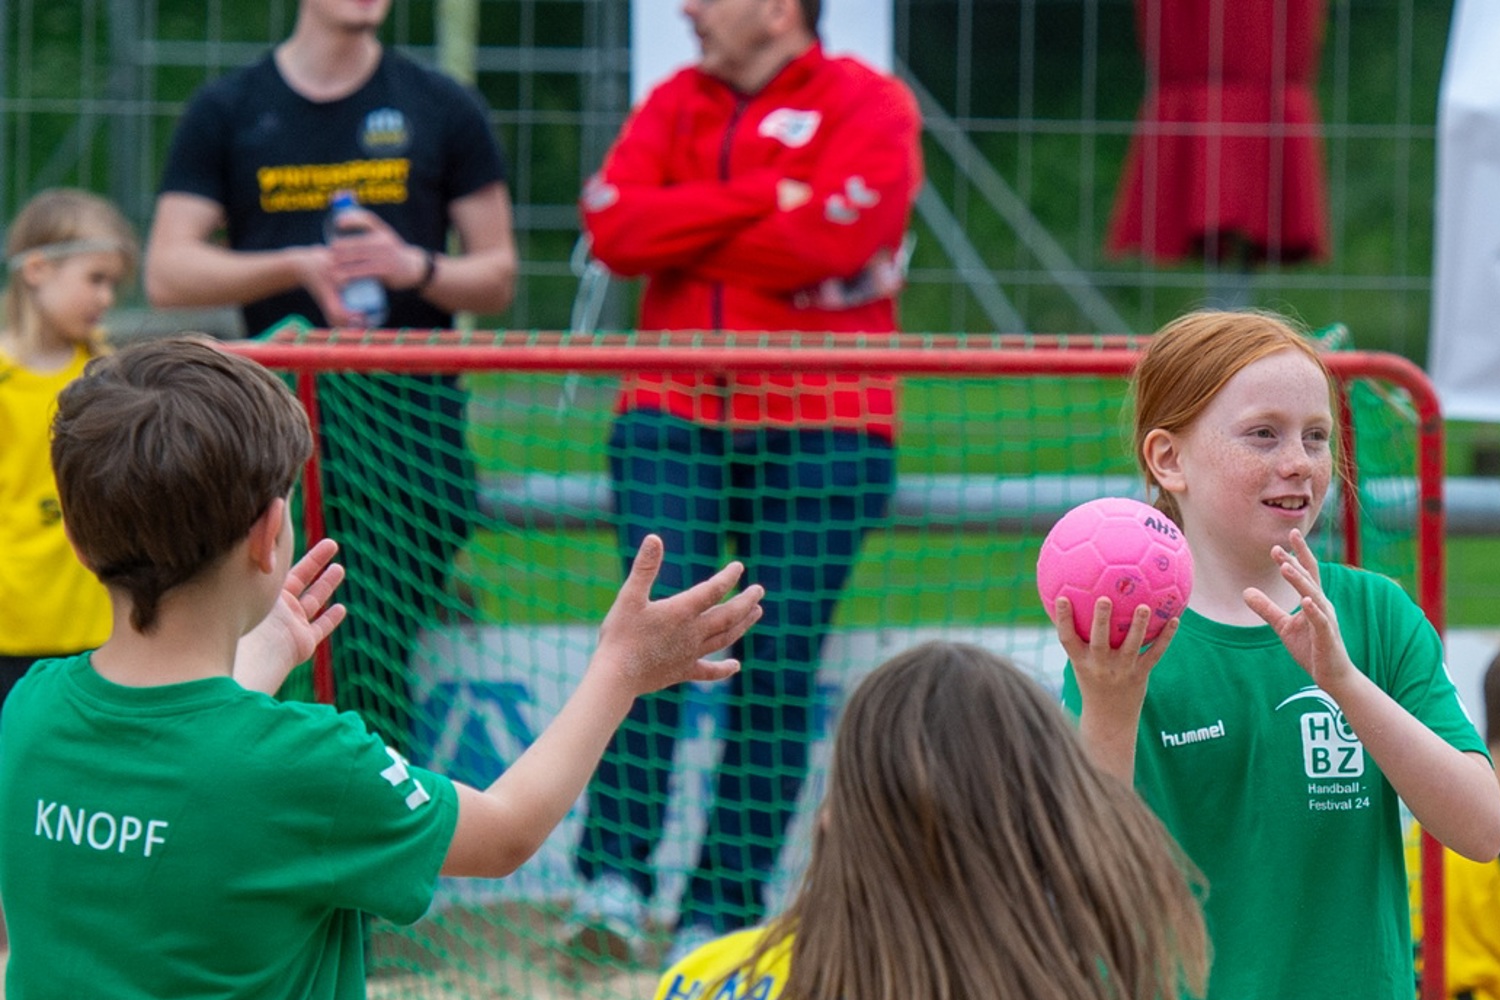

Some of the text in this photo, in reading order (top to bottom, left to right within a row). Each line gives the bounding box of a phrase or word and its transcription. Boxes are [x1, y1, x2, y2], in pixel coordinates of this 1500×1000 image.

[1161, 719, 1226, 747] hummel
[1308, 782, 1360, 795] Handball
[1308, 796, 1371, 811] Festival 24
[34, 798, 169, 858] KNOPF
